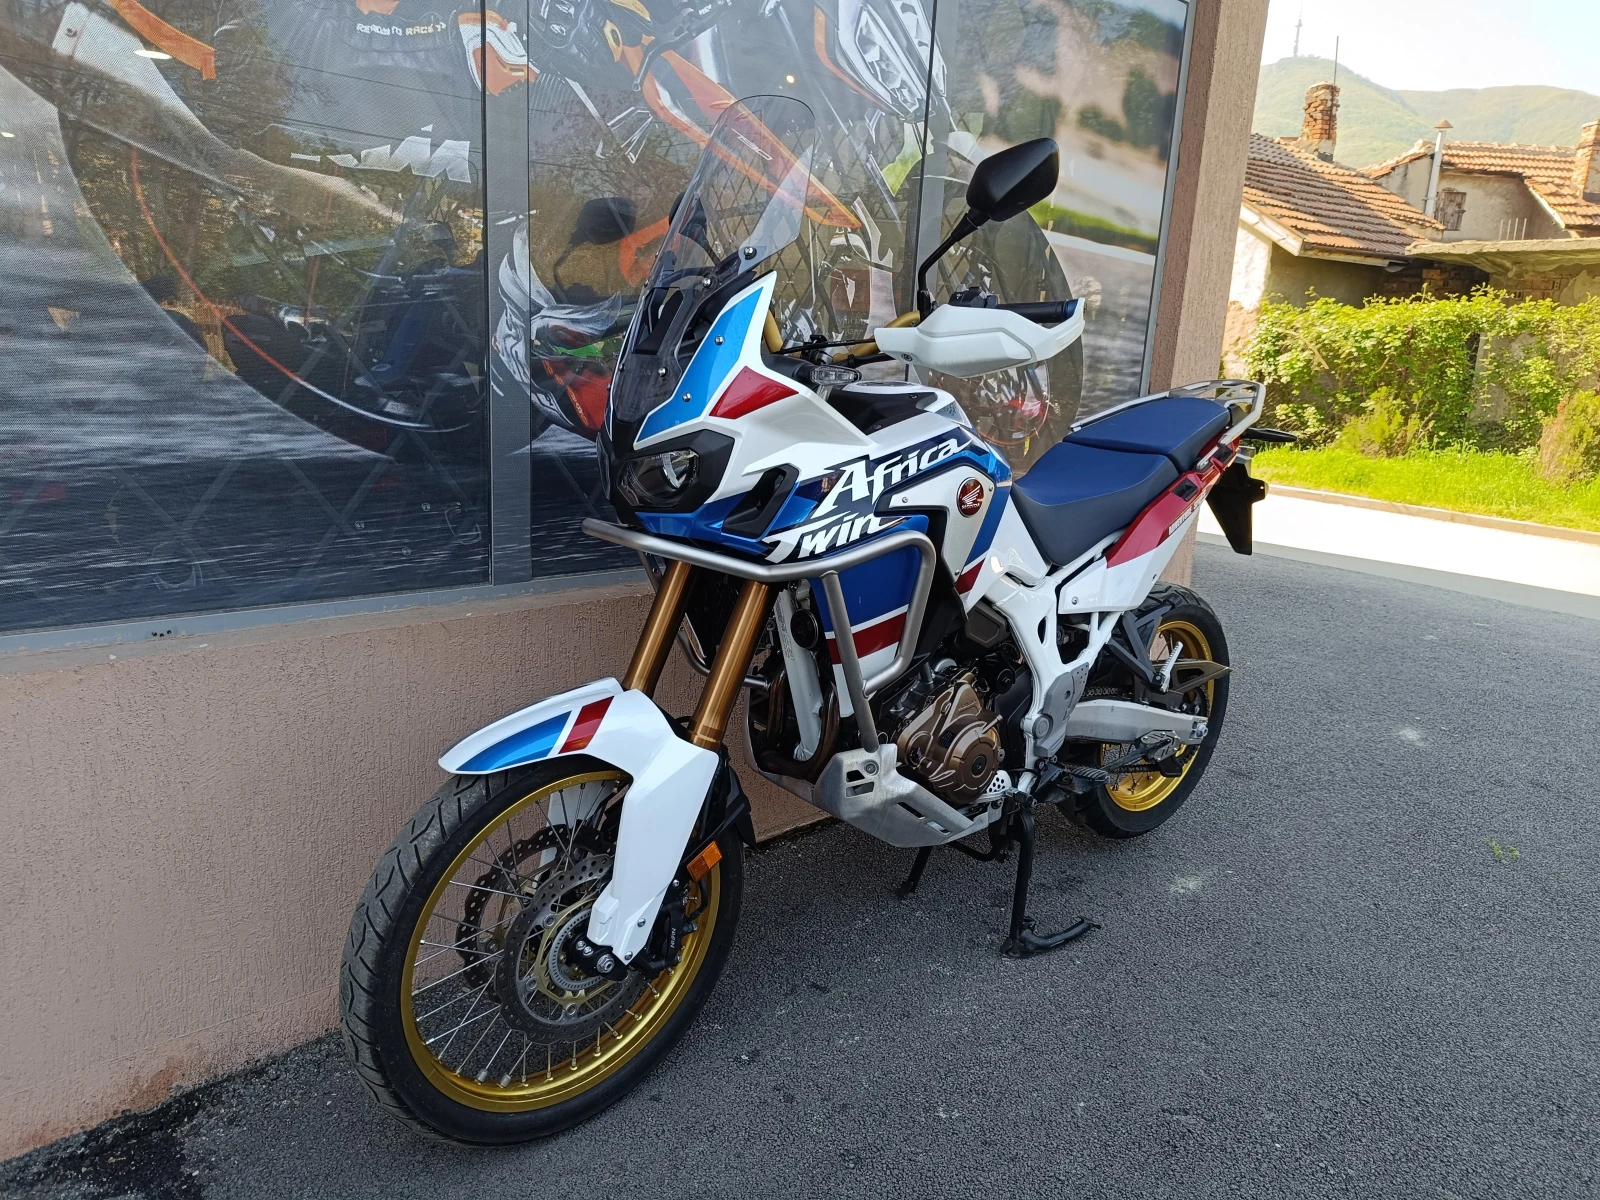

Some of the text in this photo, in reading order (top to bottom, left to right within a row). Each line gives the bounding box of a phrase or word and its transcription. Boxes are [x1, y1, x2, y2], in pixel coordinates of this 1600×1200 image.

[405, 24, 434, 36] RACE
[811, 438, 973, 519] Africa
[762, 511, 905, 563] Twin
